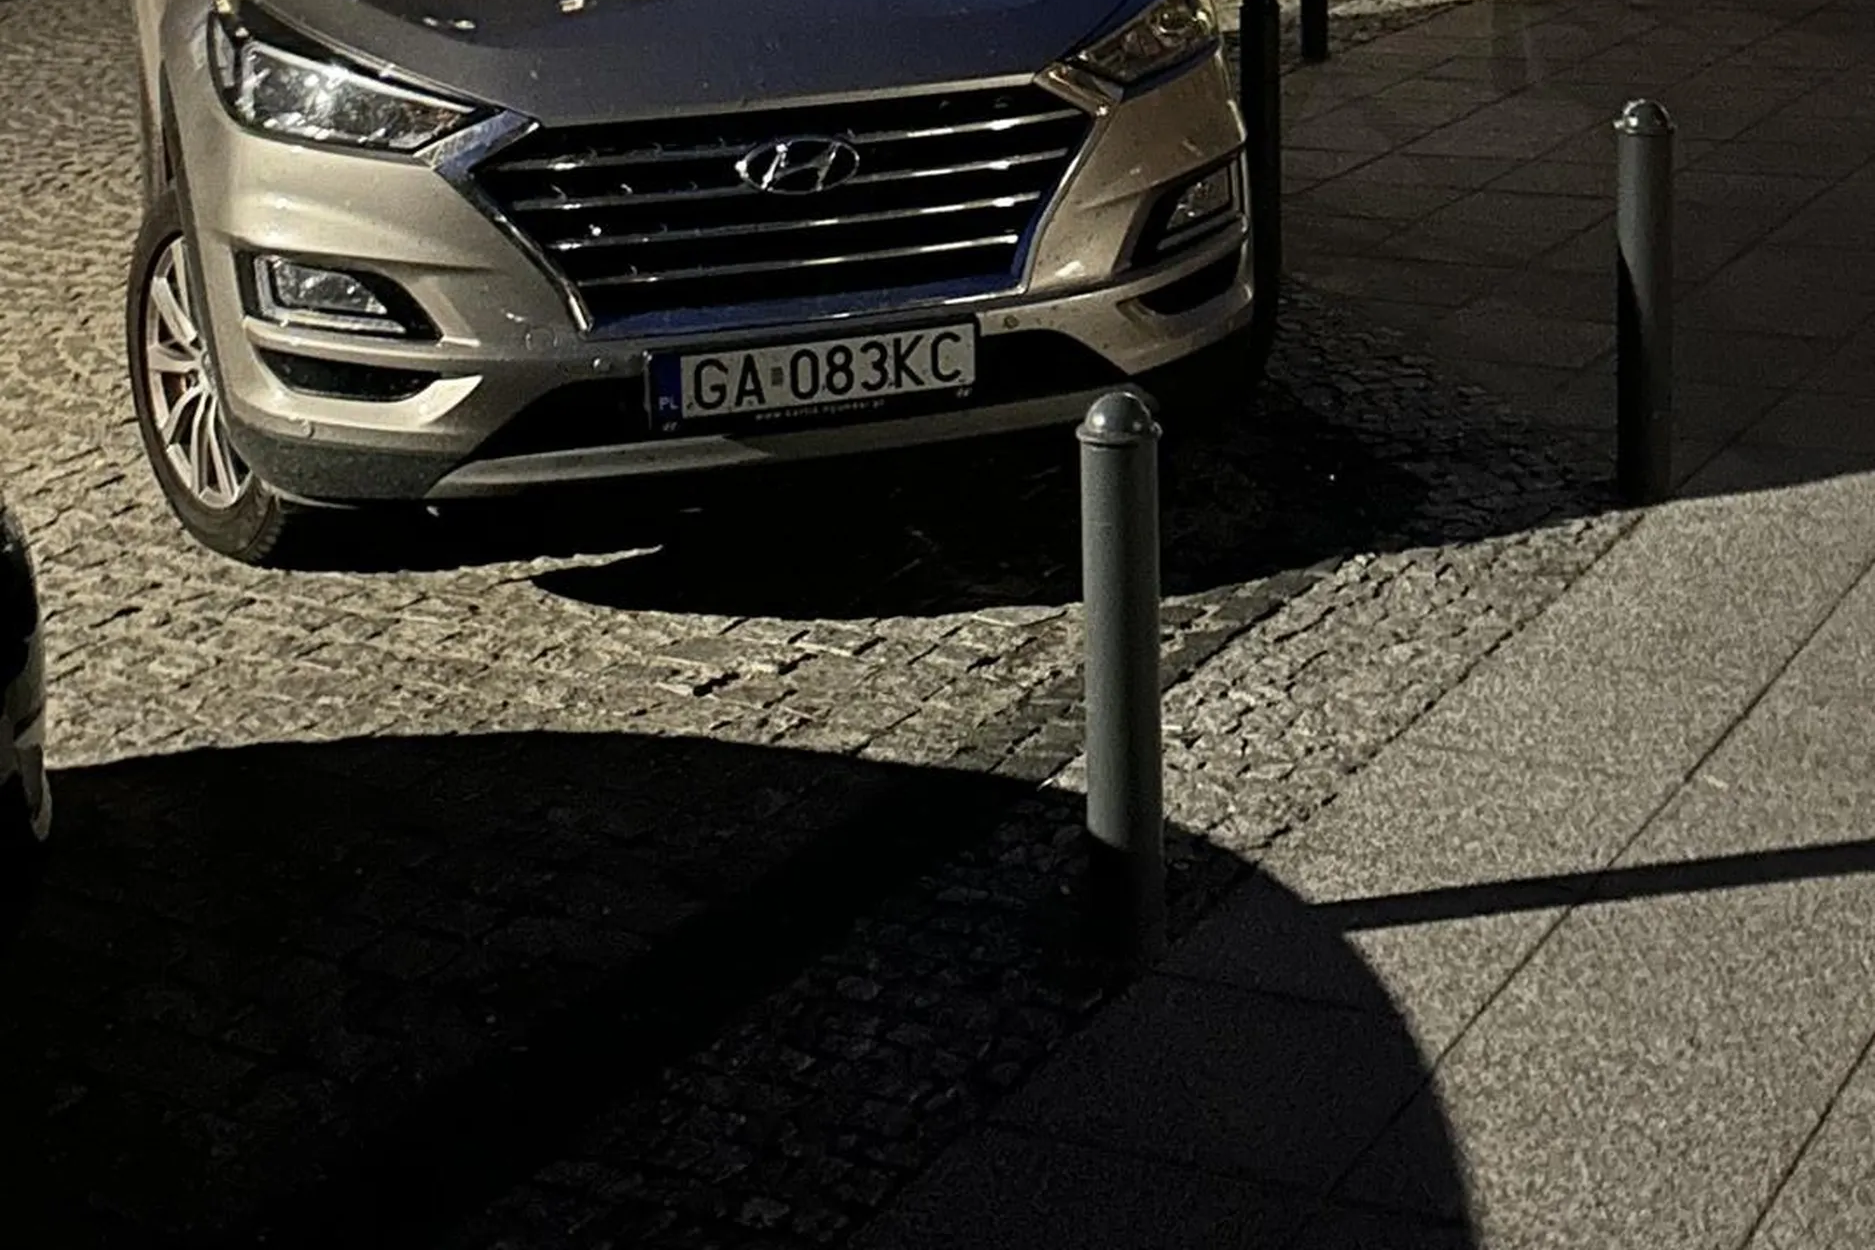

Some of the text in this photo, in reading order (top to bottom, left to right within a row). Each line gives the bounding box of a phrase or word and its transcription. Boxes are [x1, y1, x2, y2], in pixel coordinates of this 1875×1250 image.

[693, 331, 962, 410] GA 083KC
[658, 396, 680, 410] PL
